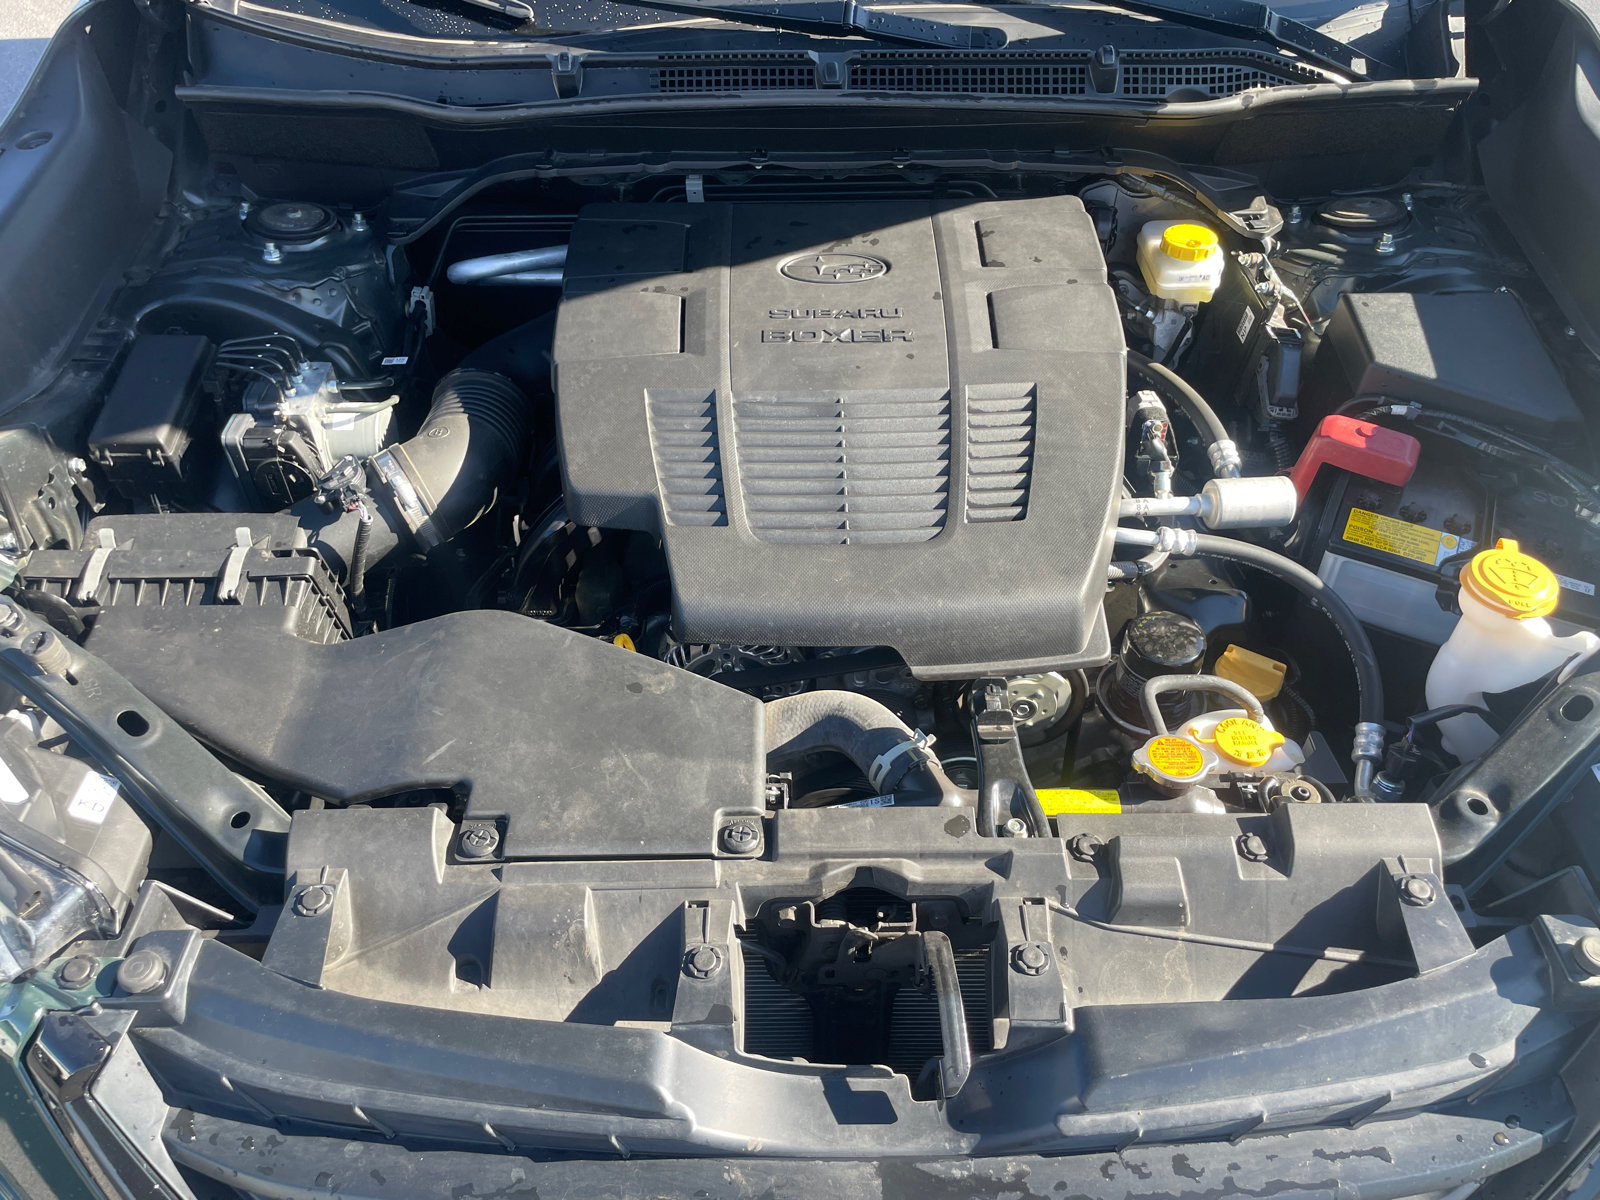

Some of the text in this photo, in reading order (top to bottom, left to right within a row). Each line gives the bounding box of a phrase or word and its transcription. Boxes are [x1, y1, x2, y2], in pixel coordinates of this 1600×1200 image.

[768, 308, 904, 320] SUBARU
[761, 328, 914, 343] BOXER
[1353, 508, 1378, 518] DANGER
[1348, 524, 1373, 534] POISON
